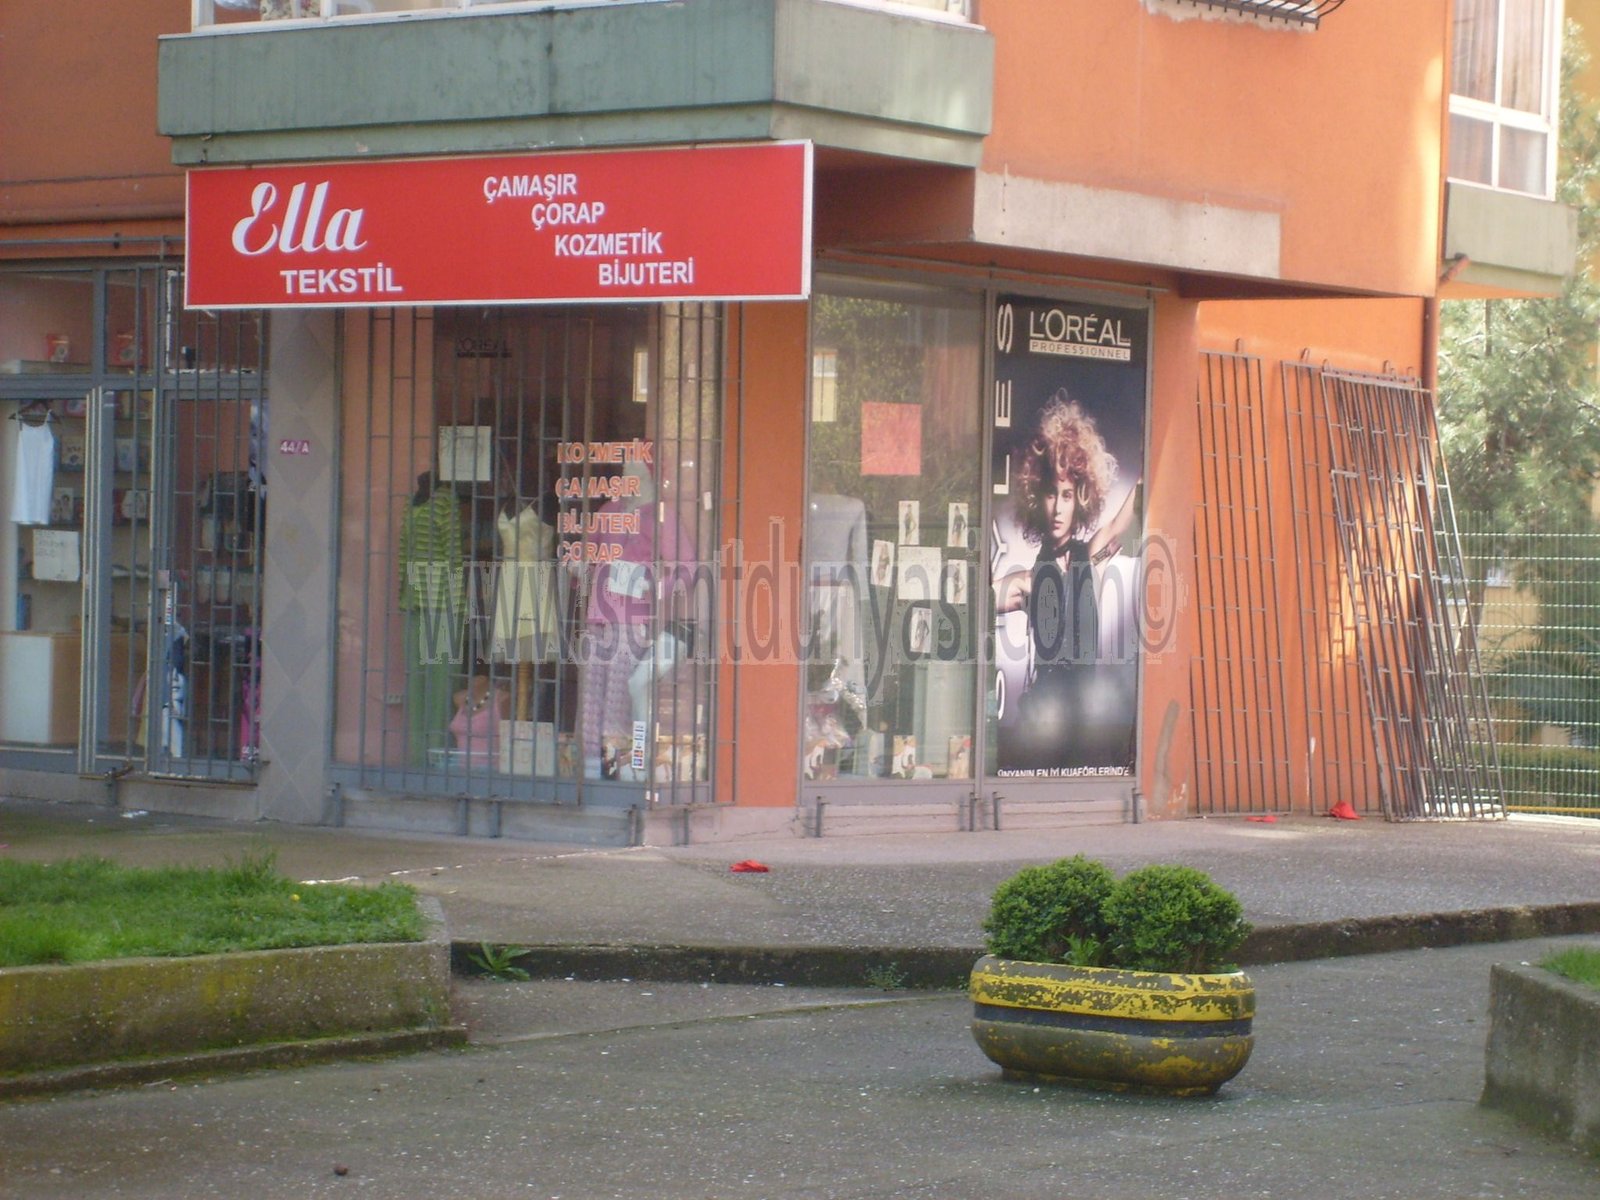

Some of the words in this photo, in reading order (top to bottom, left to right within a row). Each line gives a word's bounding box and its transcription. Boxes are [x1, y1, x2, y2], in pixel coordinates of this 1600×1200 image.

[483, 173, 578, 204] ÇAMAŞIR
[231, 181, 368, 256] Ella
[531, 202, 606, 232] ÇORAP
[554, 228, 663, 258] KOZMETİK
[280, 262, 404, 295] TEKSTİL
[598, 256, 695, 287] BİJUTERİ
[1029, 309, 1132, 347] L'ORÉAL
[1030, 342, 1130, 360] PROFESSIONNEL
[557, 437, 654, 464] KOZMETİK
[557, 508, 641, 534] BİJUTERİ
